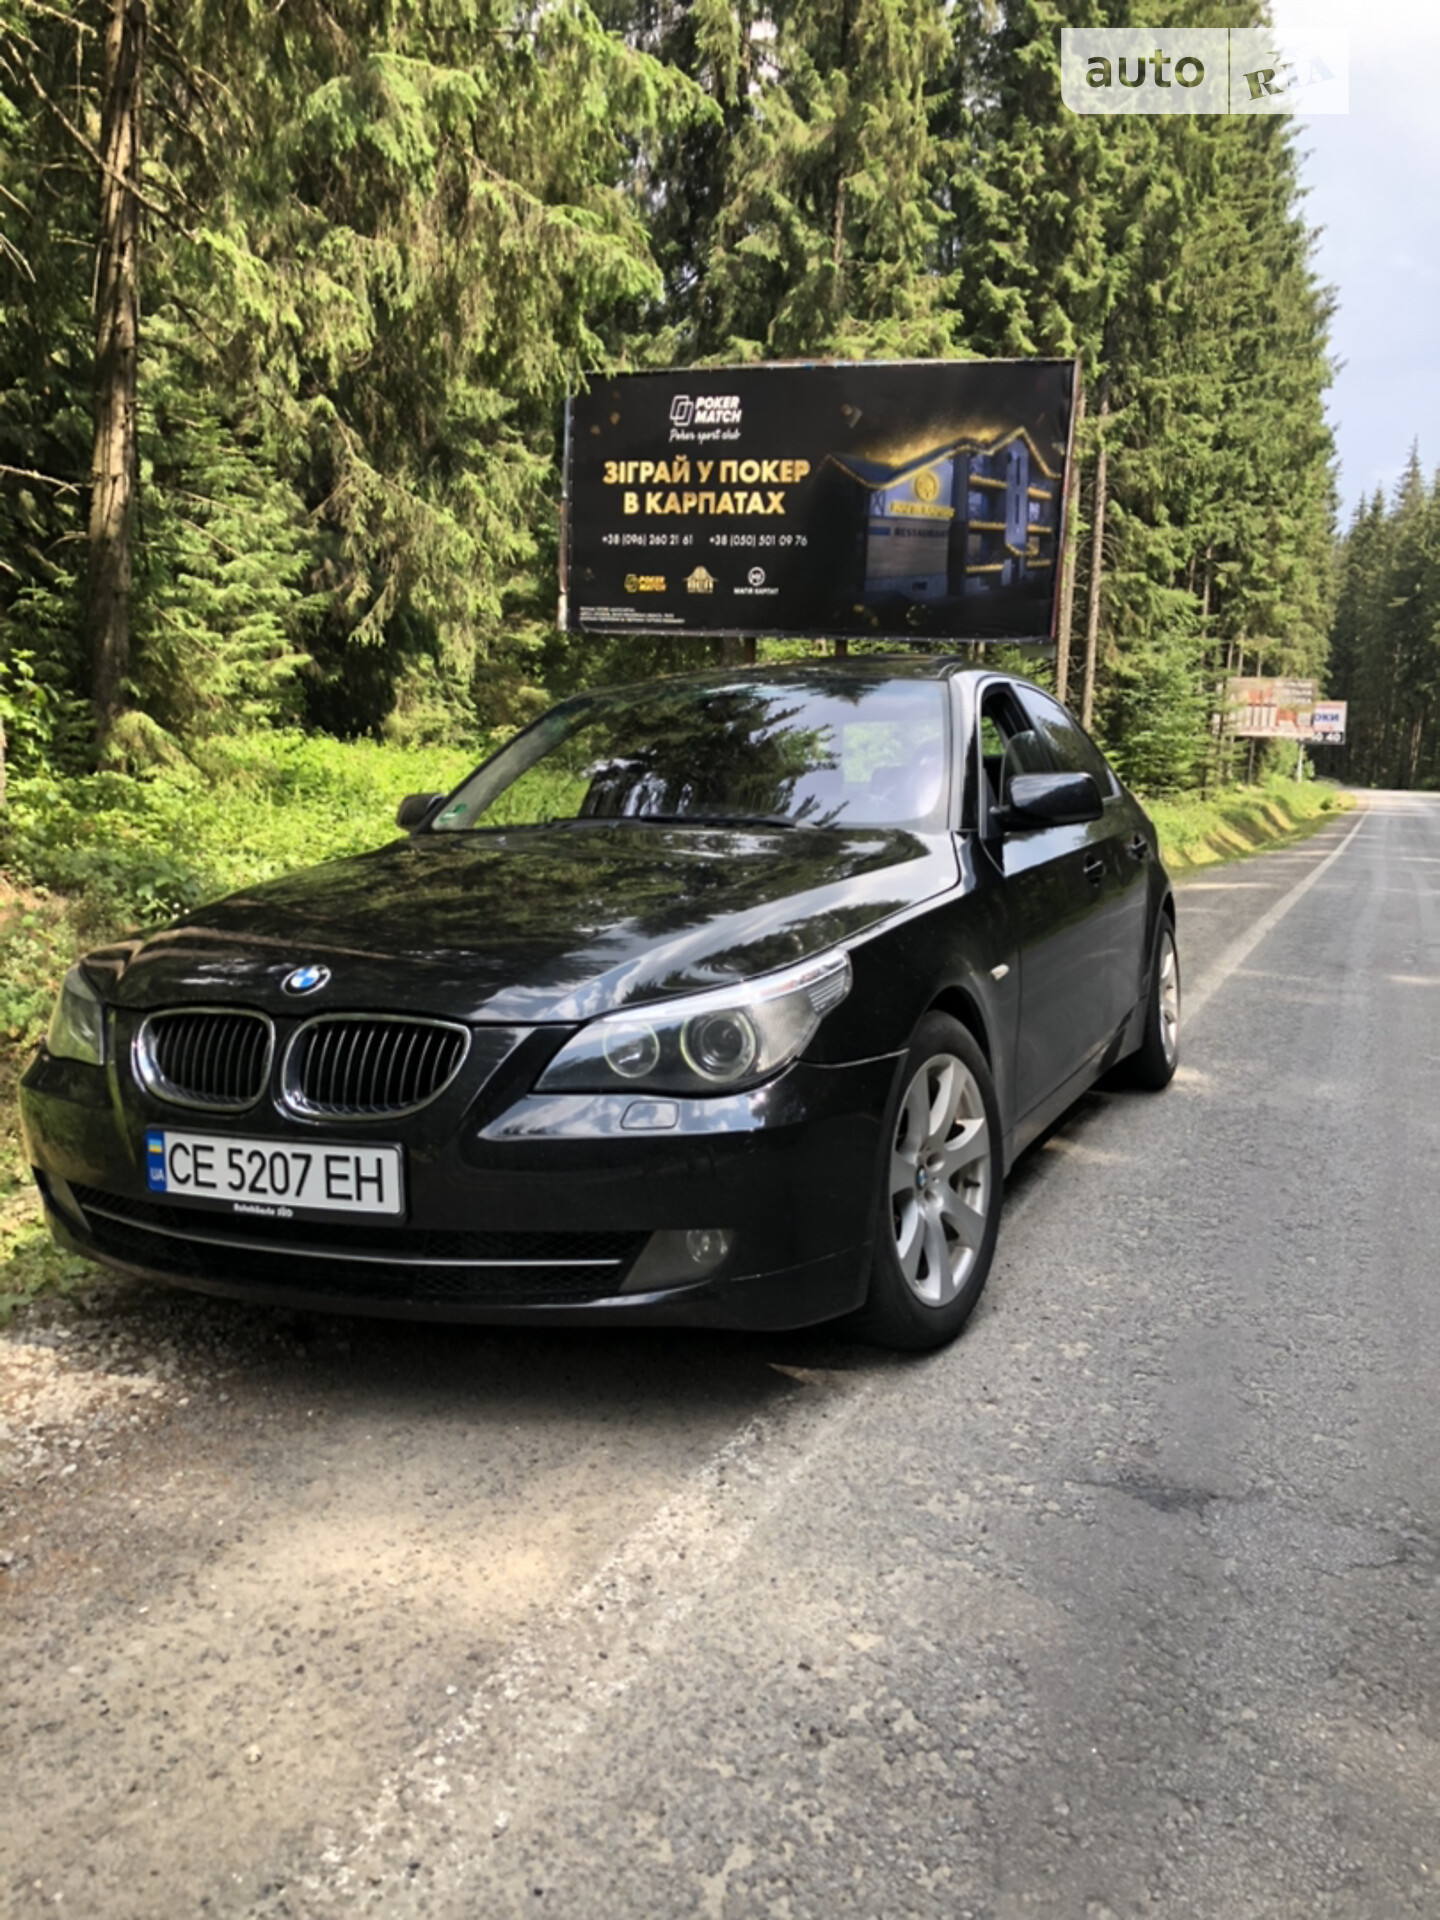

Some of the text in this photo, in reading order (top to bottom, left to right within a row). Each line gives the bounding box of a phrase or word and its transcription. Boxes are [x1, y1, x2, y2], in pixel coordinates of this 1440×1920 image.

[695, 397, 740, 409] POKER
[694, 410, 742, 424] MATCH
[603, 455, 811, 484] ЗІГРАЙ У ПОКЕР
[624, 492, 786, 514] В КАРПАТАХ
[602, 533, 693, 546] +38 (096) 260 21 61
[709, 534, 808, 547] +38 (050) 501 09 76
[150, 1167, 165, 1181] UA
[168, 1142, 384, 1203] CE 5207 EH
